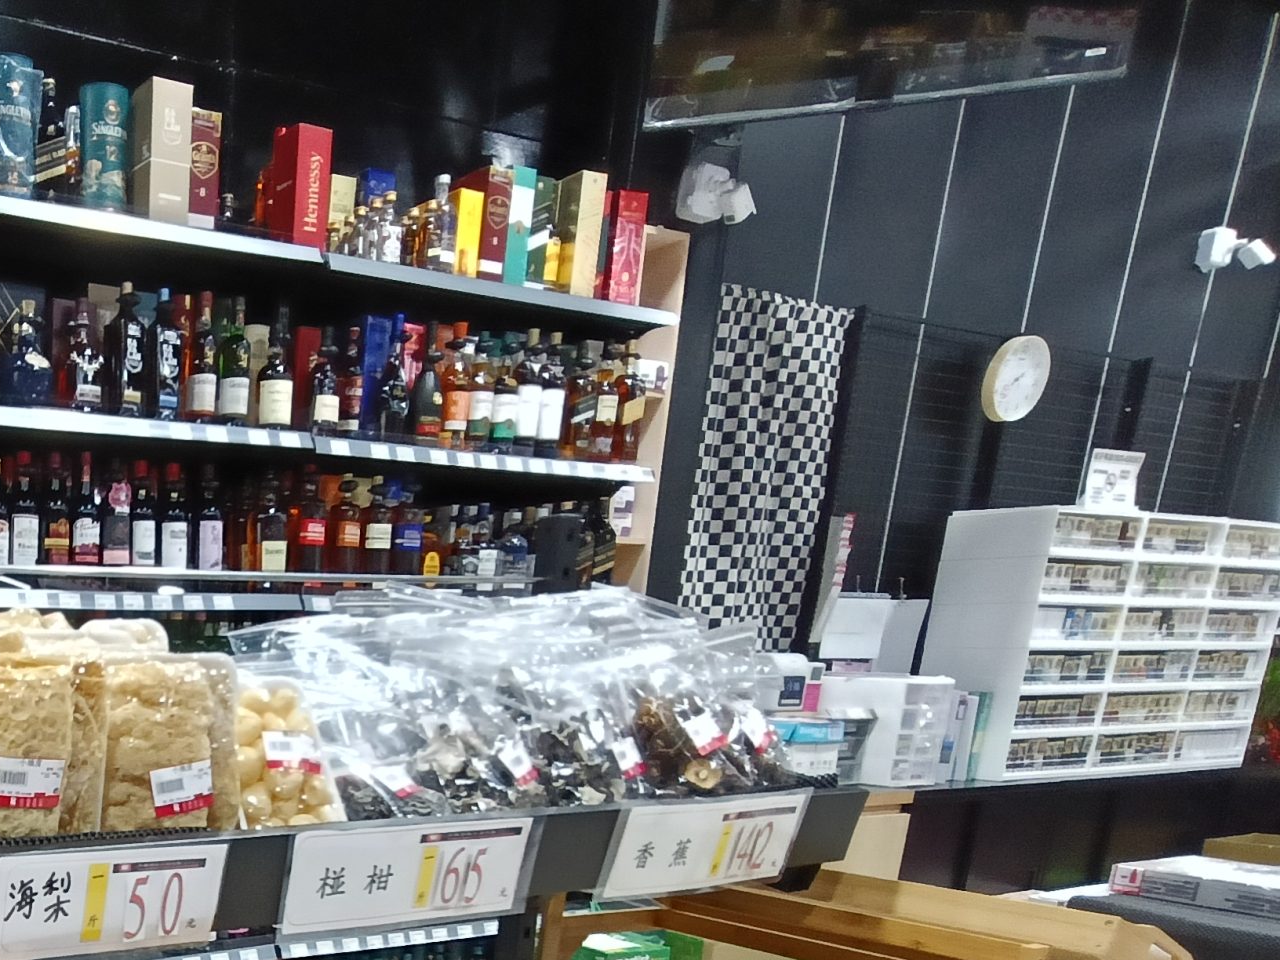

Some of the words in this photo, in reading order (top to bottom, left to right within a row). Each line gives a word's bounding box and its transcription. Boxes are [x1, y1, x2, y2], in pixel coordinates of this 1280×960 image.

[303, 151, 324, 232] Hennessy
[440, 847, 489, 904] 65
[633, 838, 692, 869] 香蕉
[3, 871, 72, 923] 海梨
[124, 872, 184, 940] 50
[316, 864, 394, 899] 椪柑
